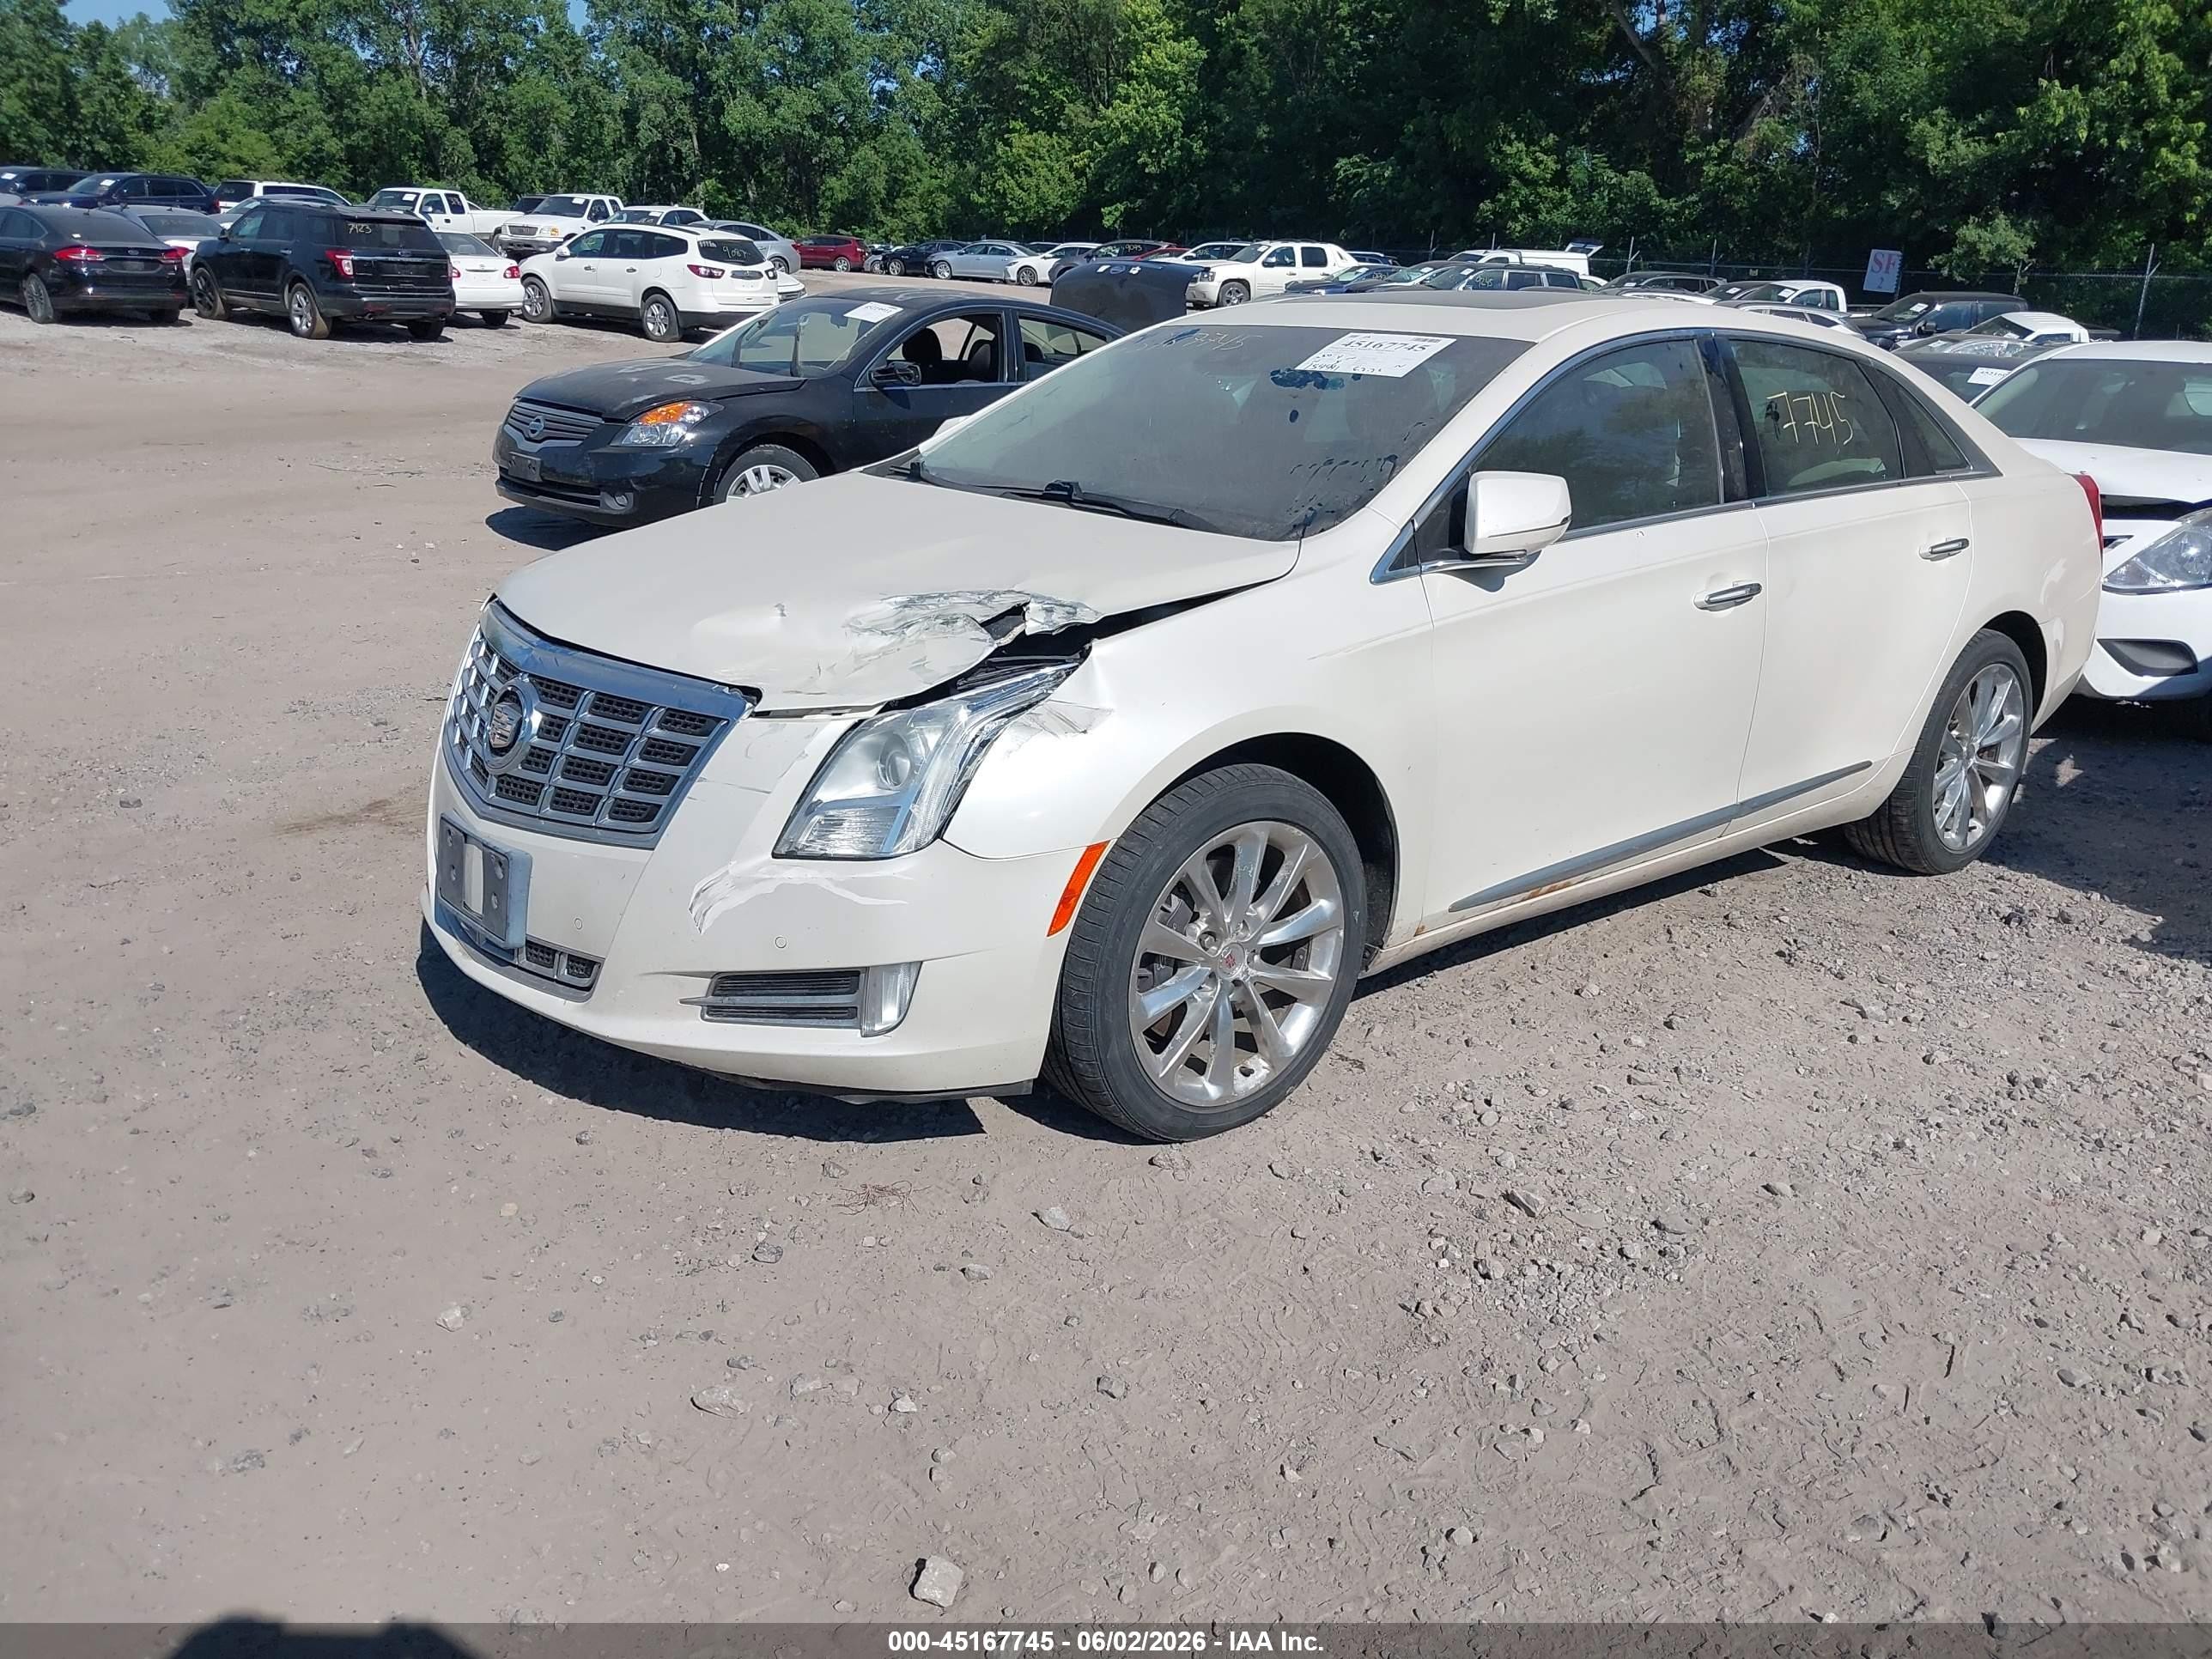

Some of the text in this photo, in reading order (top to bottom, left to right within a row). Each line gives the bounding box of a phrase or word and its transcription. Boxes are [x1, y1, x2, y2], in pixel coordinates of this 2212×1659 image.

[1870, 252, 1897, 275] SF
[1875, 276, 1885, 289] 2
[1340, 339, 1431, 353] 45167745
[1766, 391, 1855, 446] 7745
